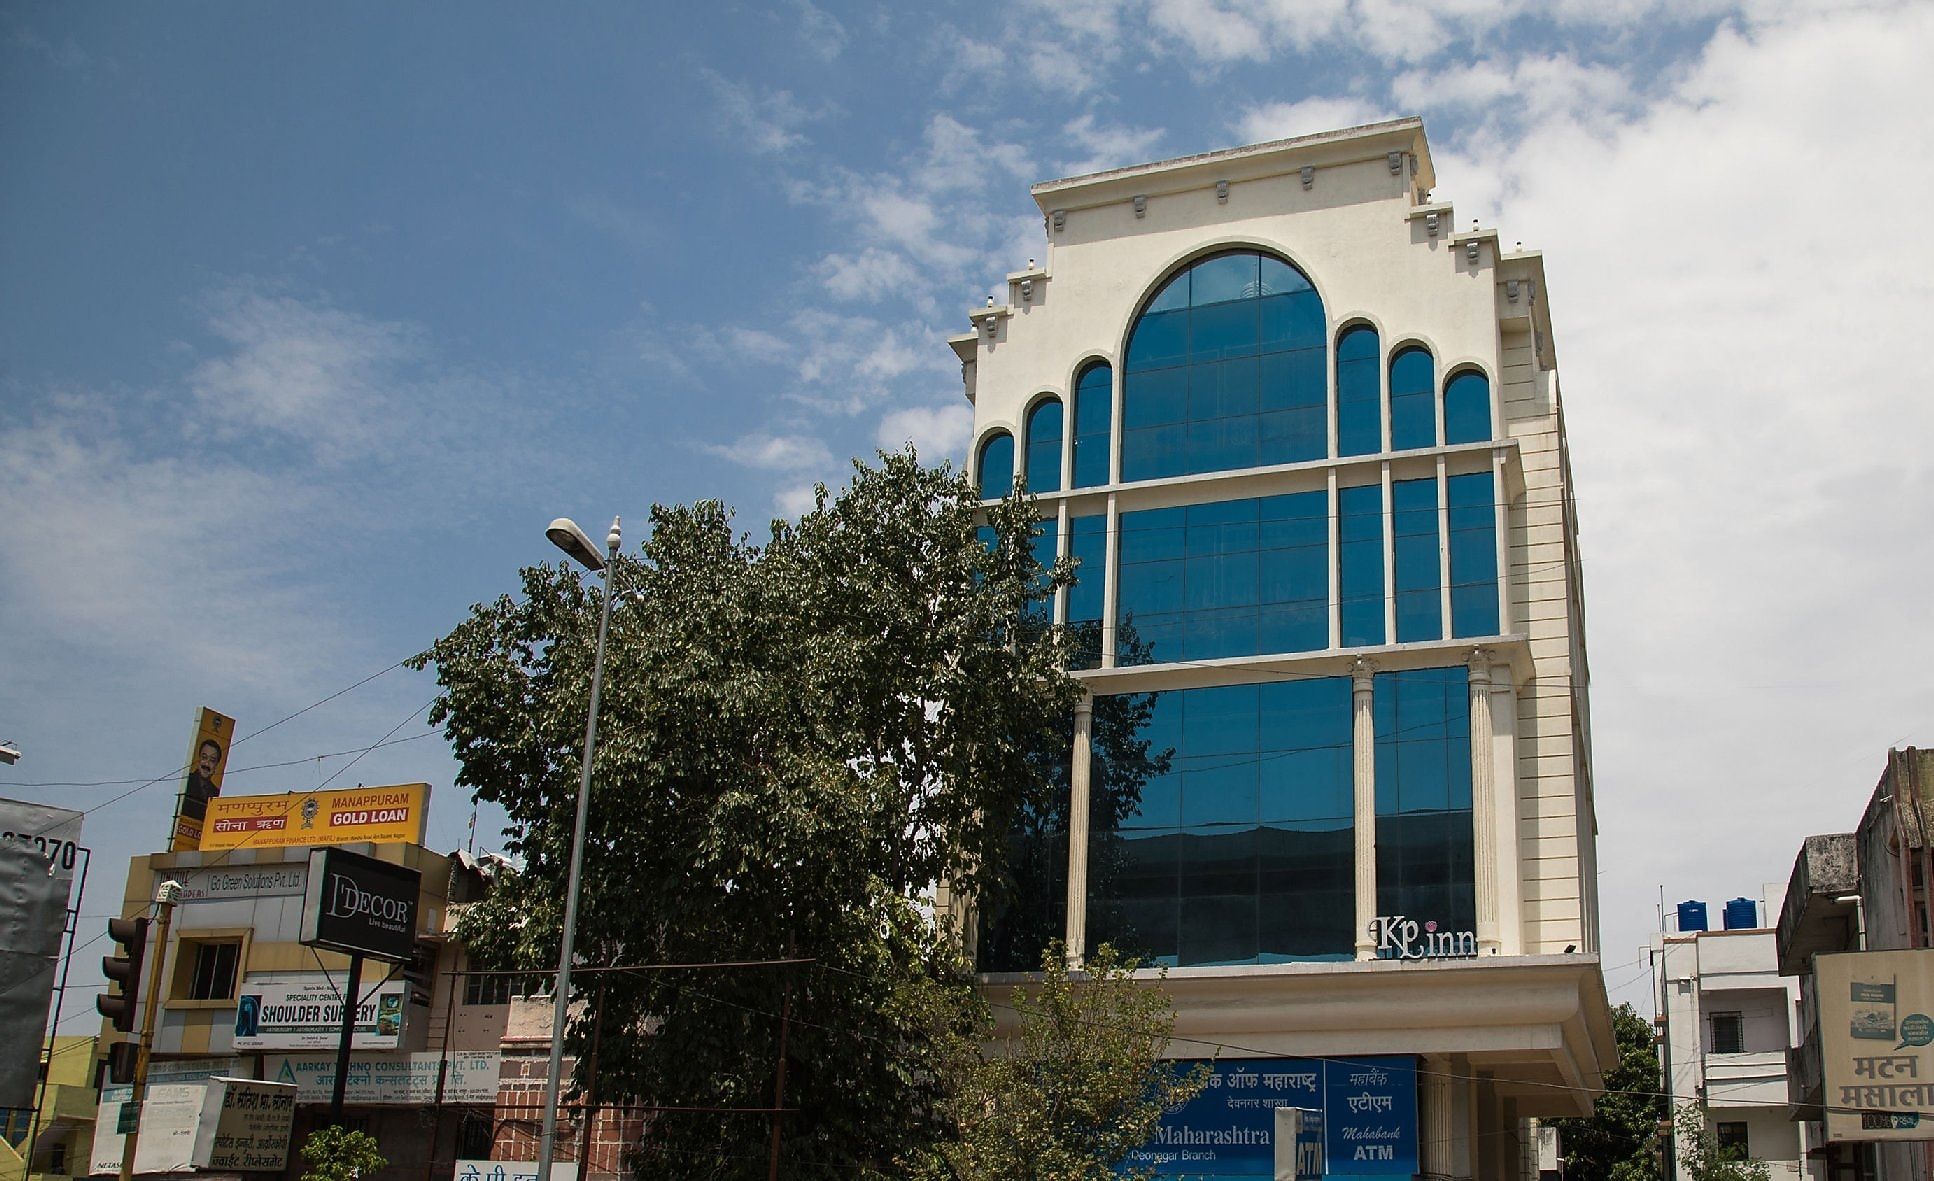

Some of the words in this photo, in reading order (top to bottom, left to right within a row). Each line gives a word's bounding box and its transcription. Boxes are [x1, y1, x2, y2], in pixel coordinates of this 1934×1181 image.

[332, 793, 409, 808] MANAPPURAM
[333, 812, 367, 825] GOLD
[371, 809, 407, 823] LOAN
[216, 819, 248, 832] सोना
[257, 819, 286, 830] ऋण
[211, 875, 220, 890] Go
[222, 874, 242, 890] Green
[244, 873, 273, 889] Solutions
[1425, 920, 1477, 957] inn
[286, 994, 317, 1002] SPECIALITY
[262, 1004, 321, 1024] SHOULDER
[323, 1003, 377, 1023] SURERY
[296, 1061, 331, 1073] AARKAY
[470, 1060, 490, 1071] LTD.
[1852, 1055, 1919, 1079] मटन
[1227, 1067, 1259, 1089] ऑफ
[1263, 1073, 1317, 1092] महाराष्ट्र
[1347, 1092, 1392, 1113] एटीएम
[1839, 1084, 1934, 1107] मसाला
[1154, 1125, 1270, 1145] Maharashtra
[1341, 1126, 1401, 1141] Mahabank
[1182, 1149, 1216, 1161] Branch
[1354, 1145, 1393, 1160] ATM
